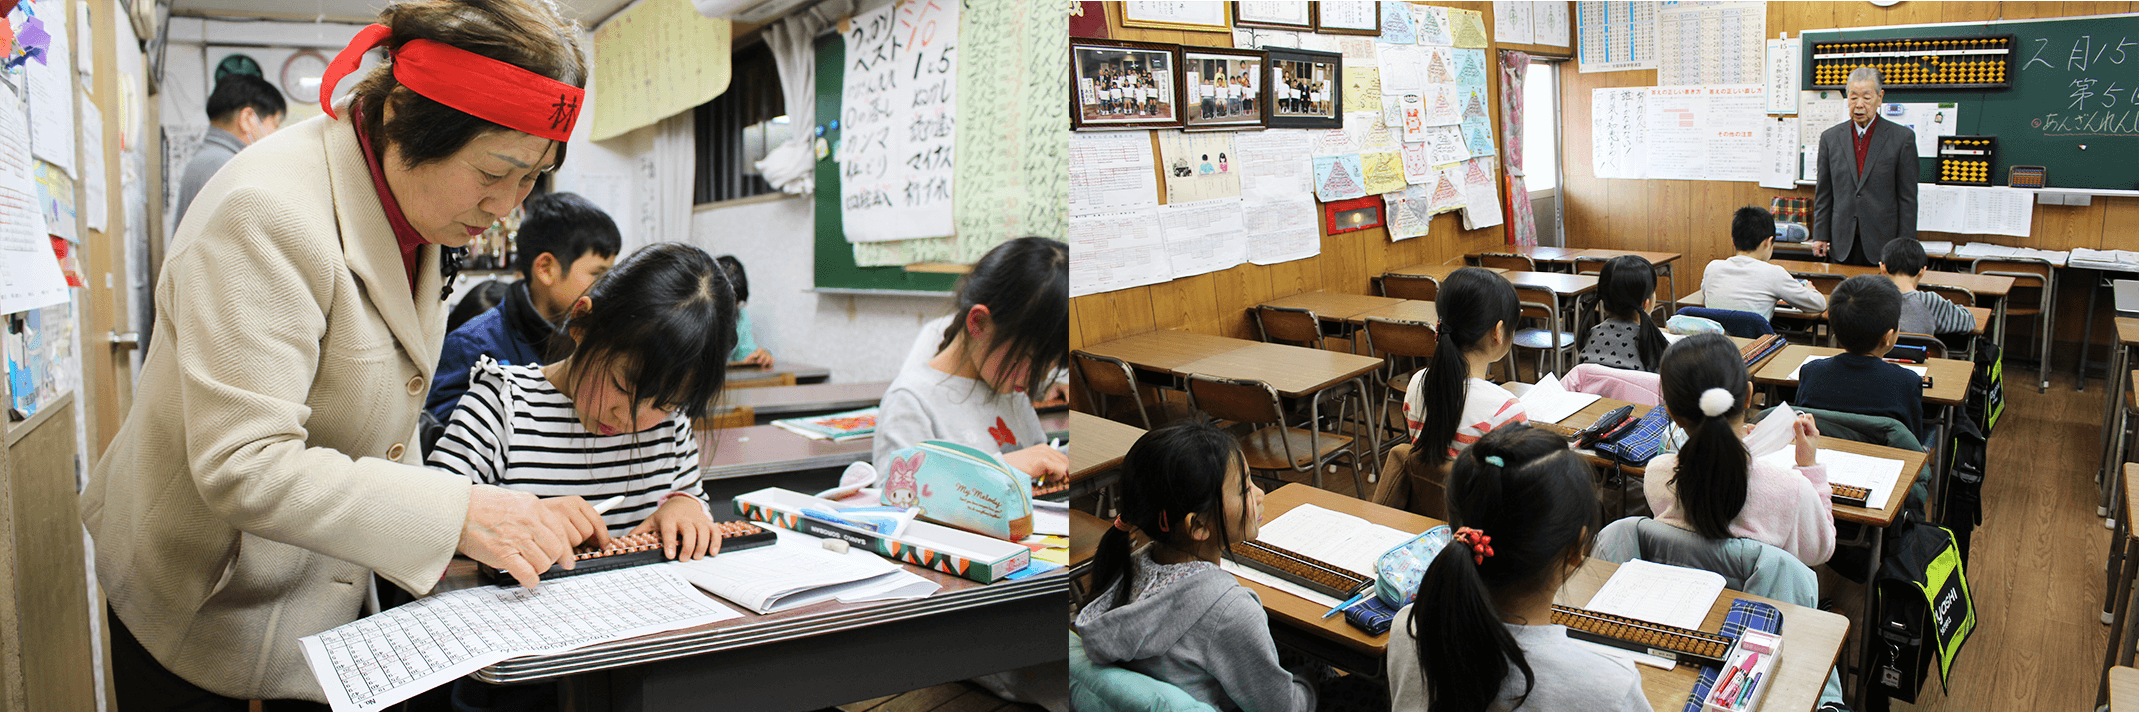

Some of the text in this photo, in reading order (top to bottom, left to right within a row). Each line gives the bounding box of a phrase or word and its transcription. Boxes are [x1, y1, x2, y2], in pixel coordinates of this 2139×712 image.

[548, 93, 577, 133] 林
[955, 482, 972, 497] My
[972, 488, 1003, 509] Melody
